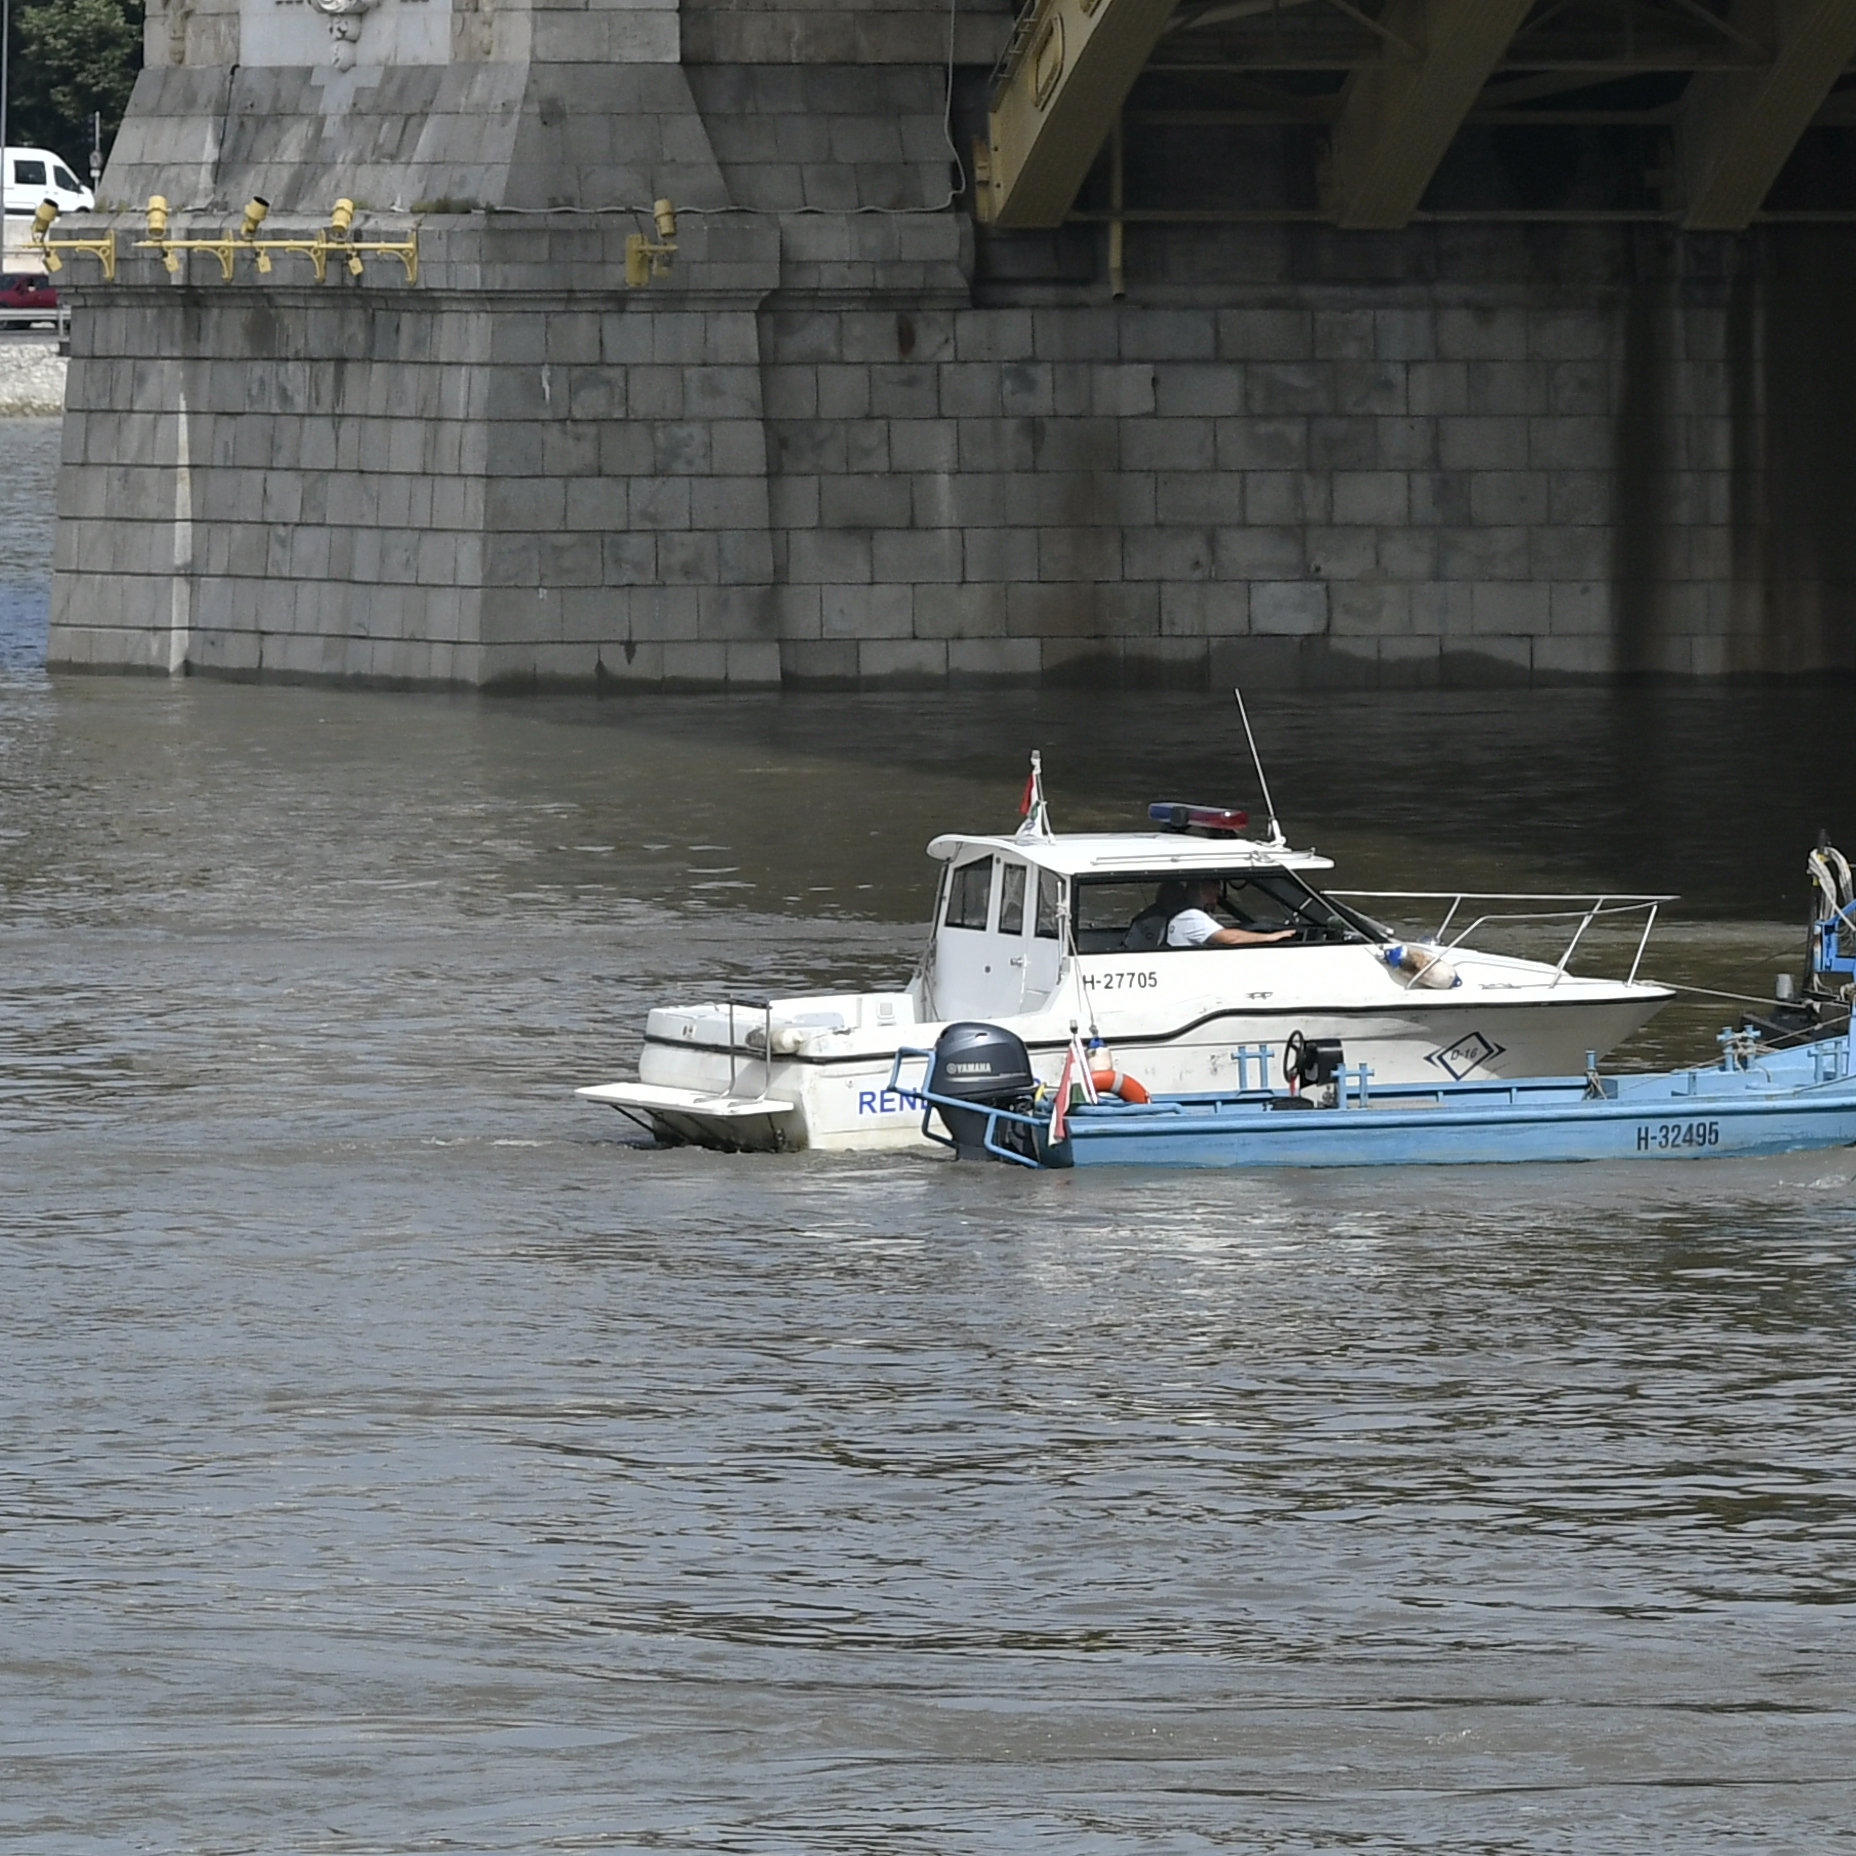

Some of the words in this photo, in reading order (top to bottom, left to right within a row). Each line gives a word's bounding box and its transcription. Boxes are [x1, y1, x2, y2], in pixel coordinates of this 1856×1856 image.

[1082, 971, 1158, 990] H-27705
[1450, 1048, 1479, 1061] D-16
[956, 1062, 992, 1074] YAMAHA
[1637, 1122, 1719, 1151] H-32495
